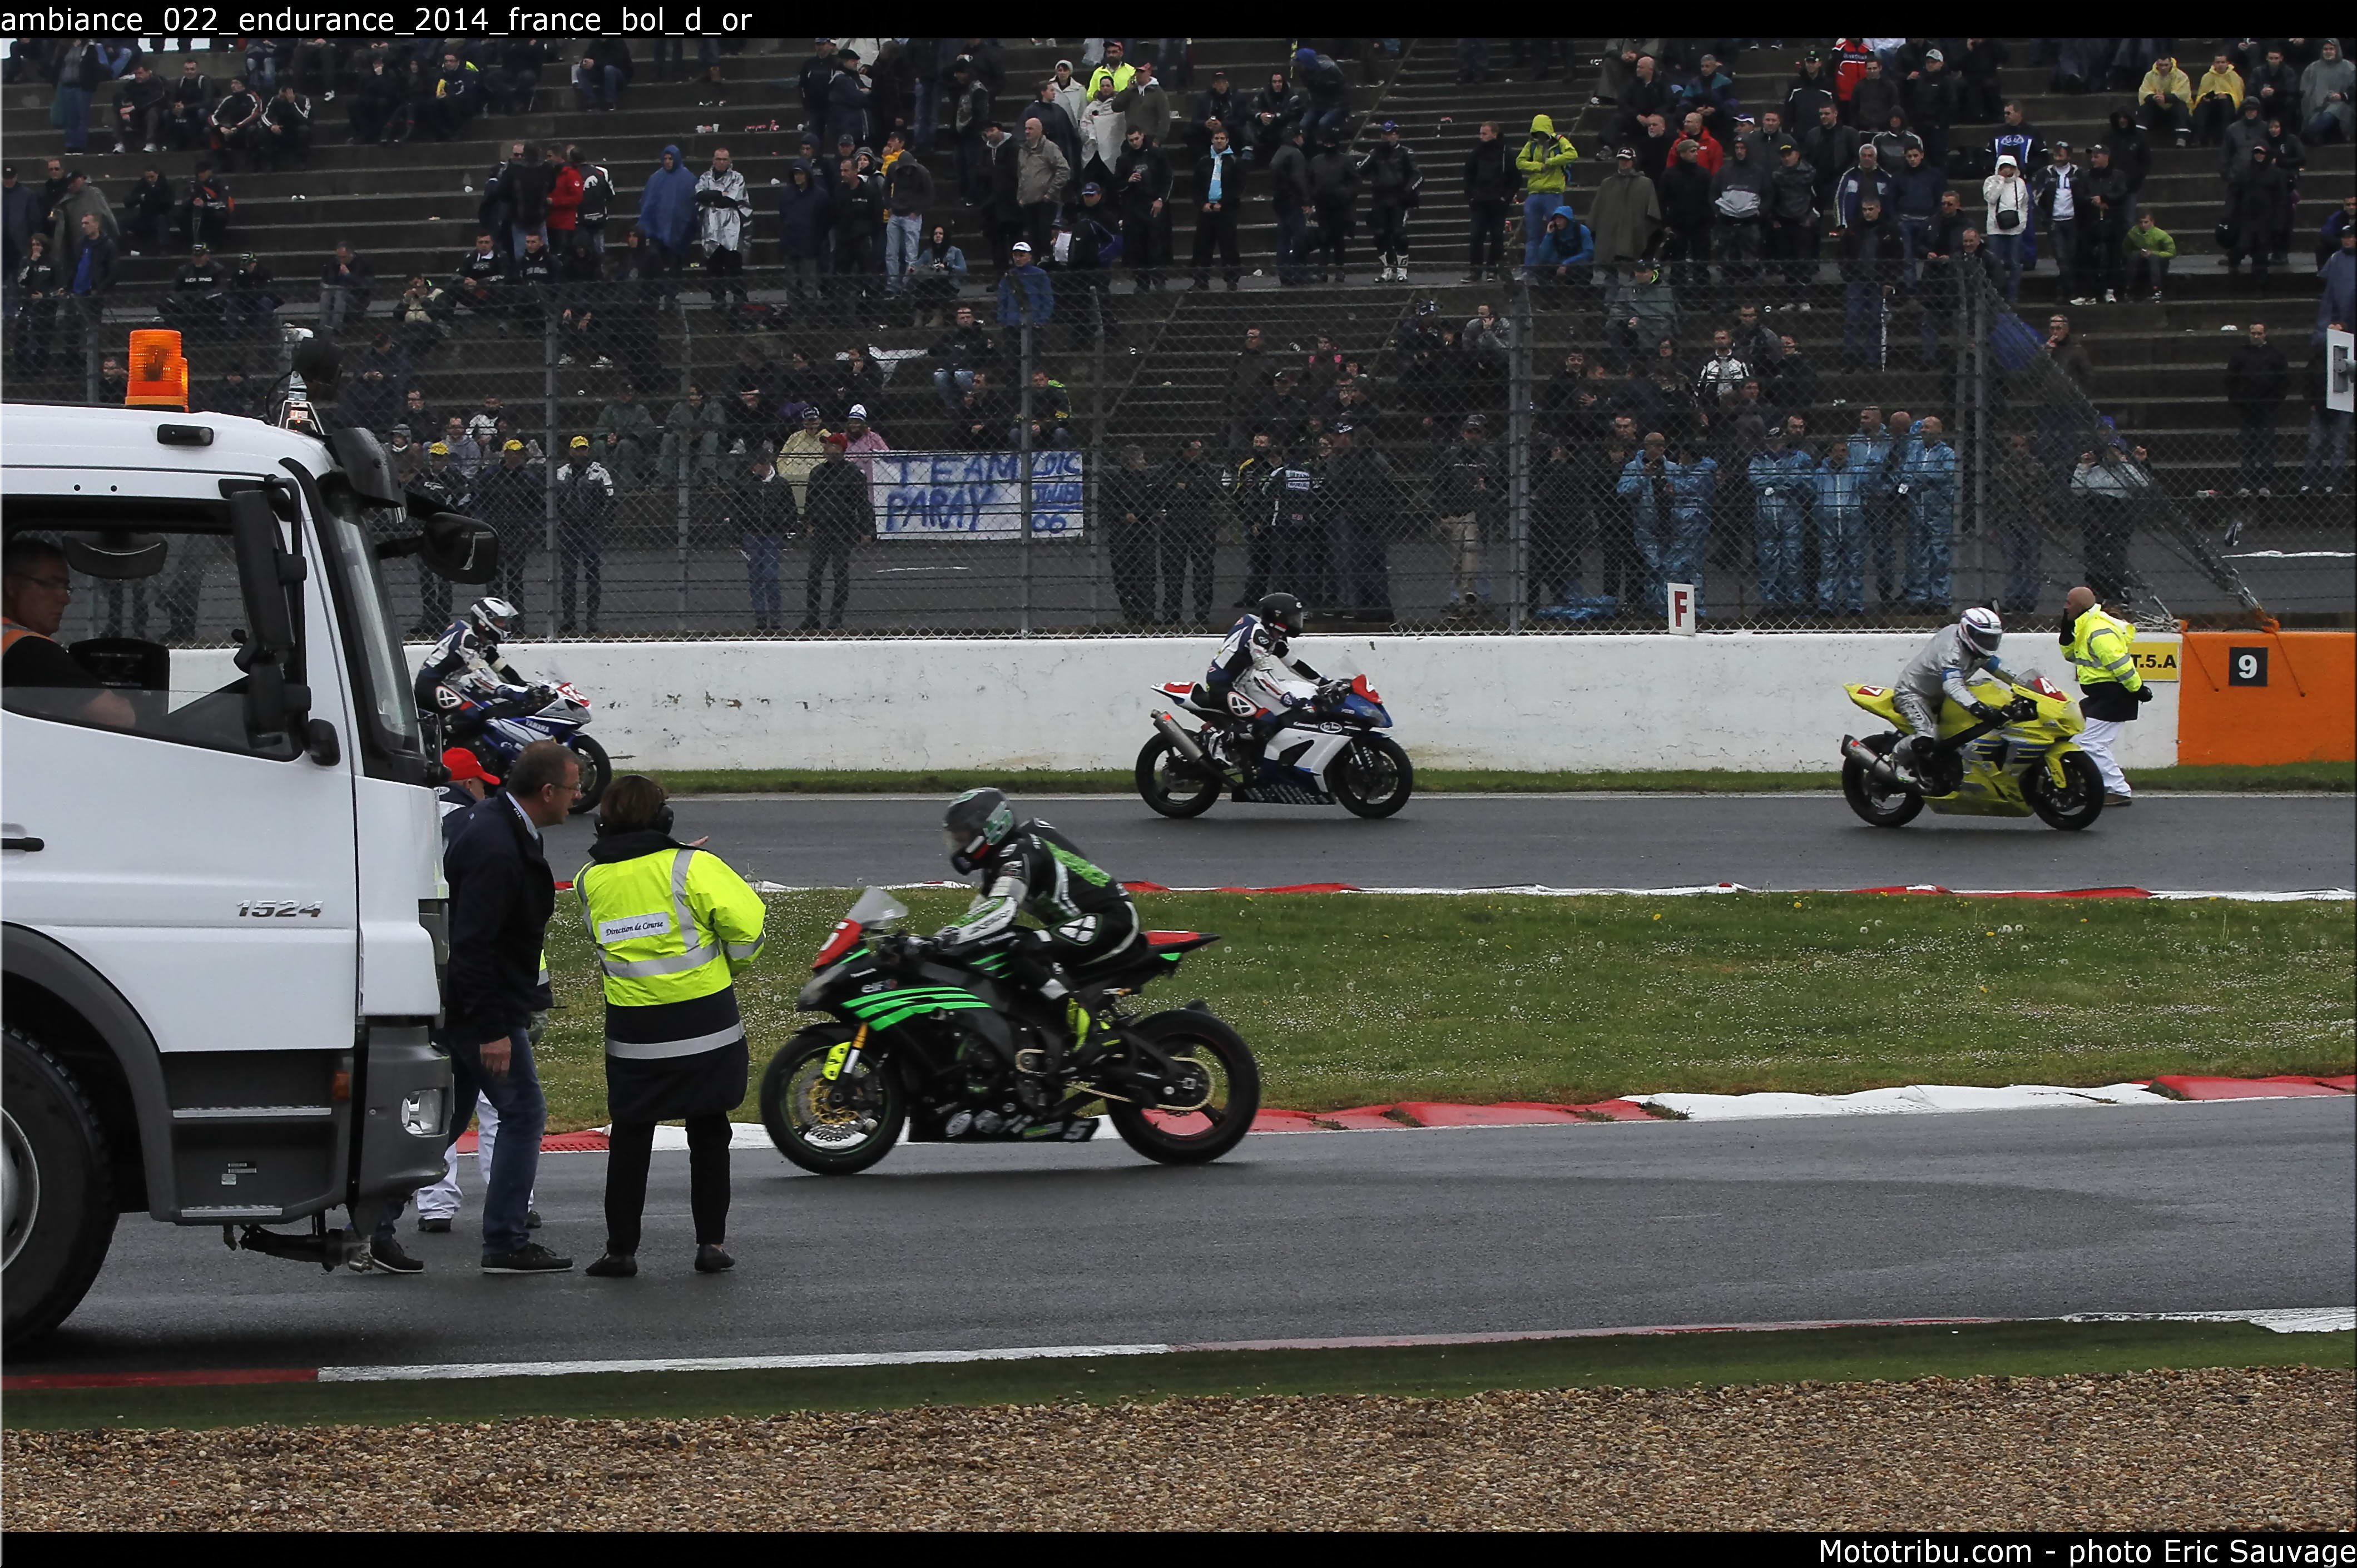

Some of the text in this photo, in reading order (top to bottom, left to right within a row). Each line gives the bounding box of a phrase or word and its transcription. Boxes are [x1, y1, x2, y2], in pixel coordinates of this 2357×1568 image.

[883, 453, 1018, 487] TEAM
[1674, 591, 1687, 627] F
[2238, 654, 2258, 679] 9
[525, 718, 550, 733] YAMAHA
[236, 899, 323, 917] 1524
[606, 926, 633, 936] Direction
[642, 921, 663, 930] Course
